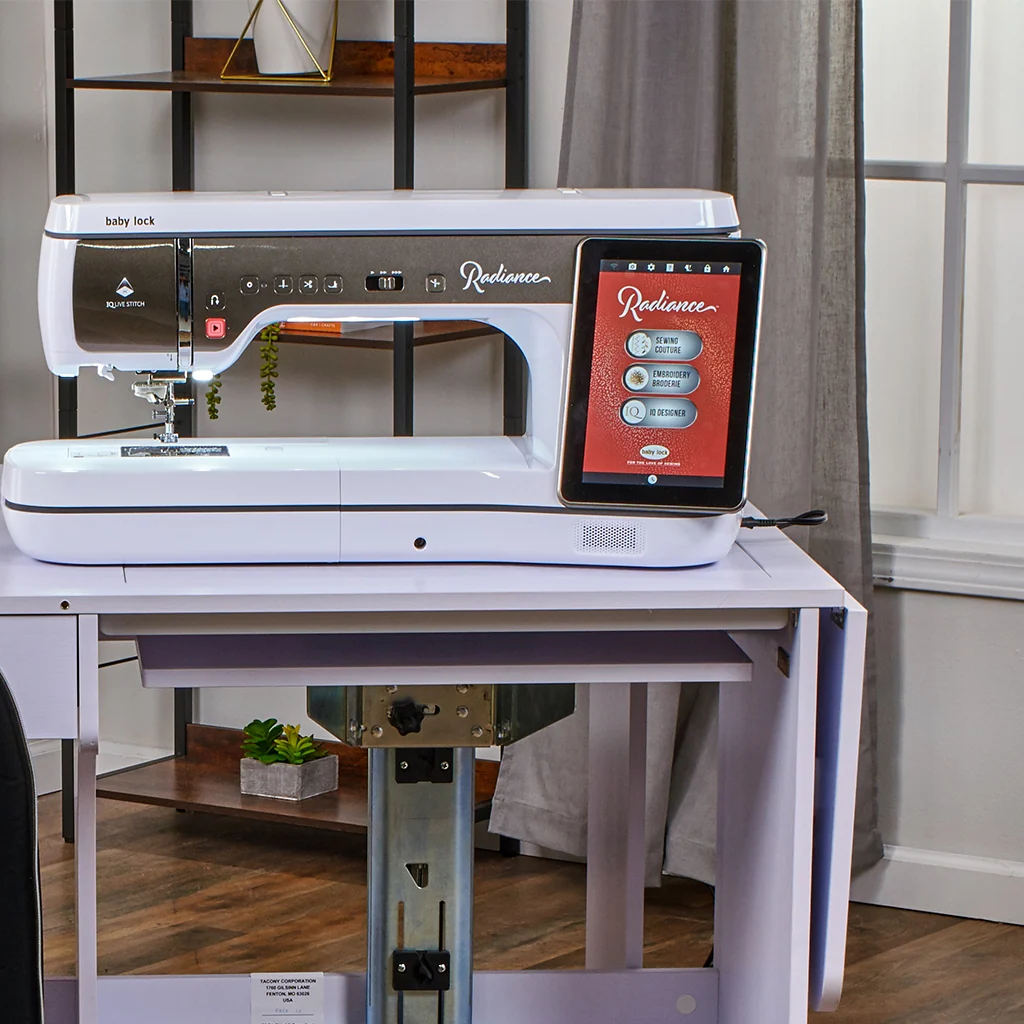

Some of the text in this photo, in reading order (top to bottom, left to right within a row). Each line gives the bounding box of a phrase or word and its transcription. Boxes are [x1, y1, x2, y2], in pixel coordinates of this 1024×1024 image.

[105, 216, 155, 228] baby lock
[459, 260, 552, 294] Radiance
[617, 285, 717, 322] Radiance
[655, 336, 679, 344] SEWING
[654, 346, 682, 354] COUTURE
[652, 370, 691, 378] EMBROIDERY
[652, 380, 681, 388] BRODERIE
[649, 408, 686, 417] IQ DESIGNER
